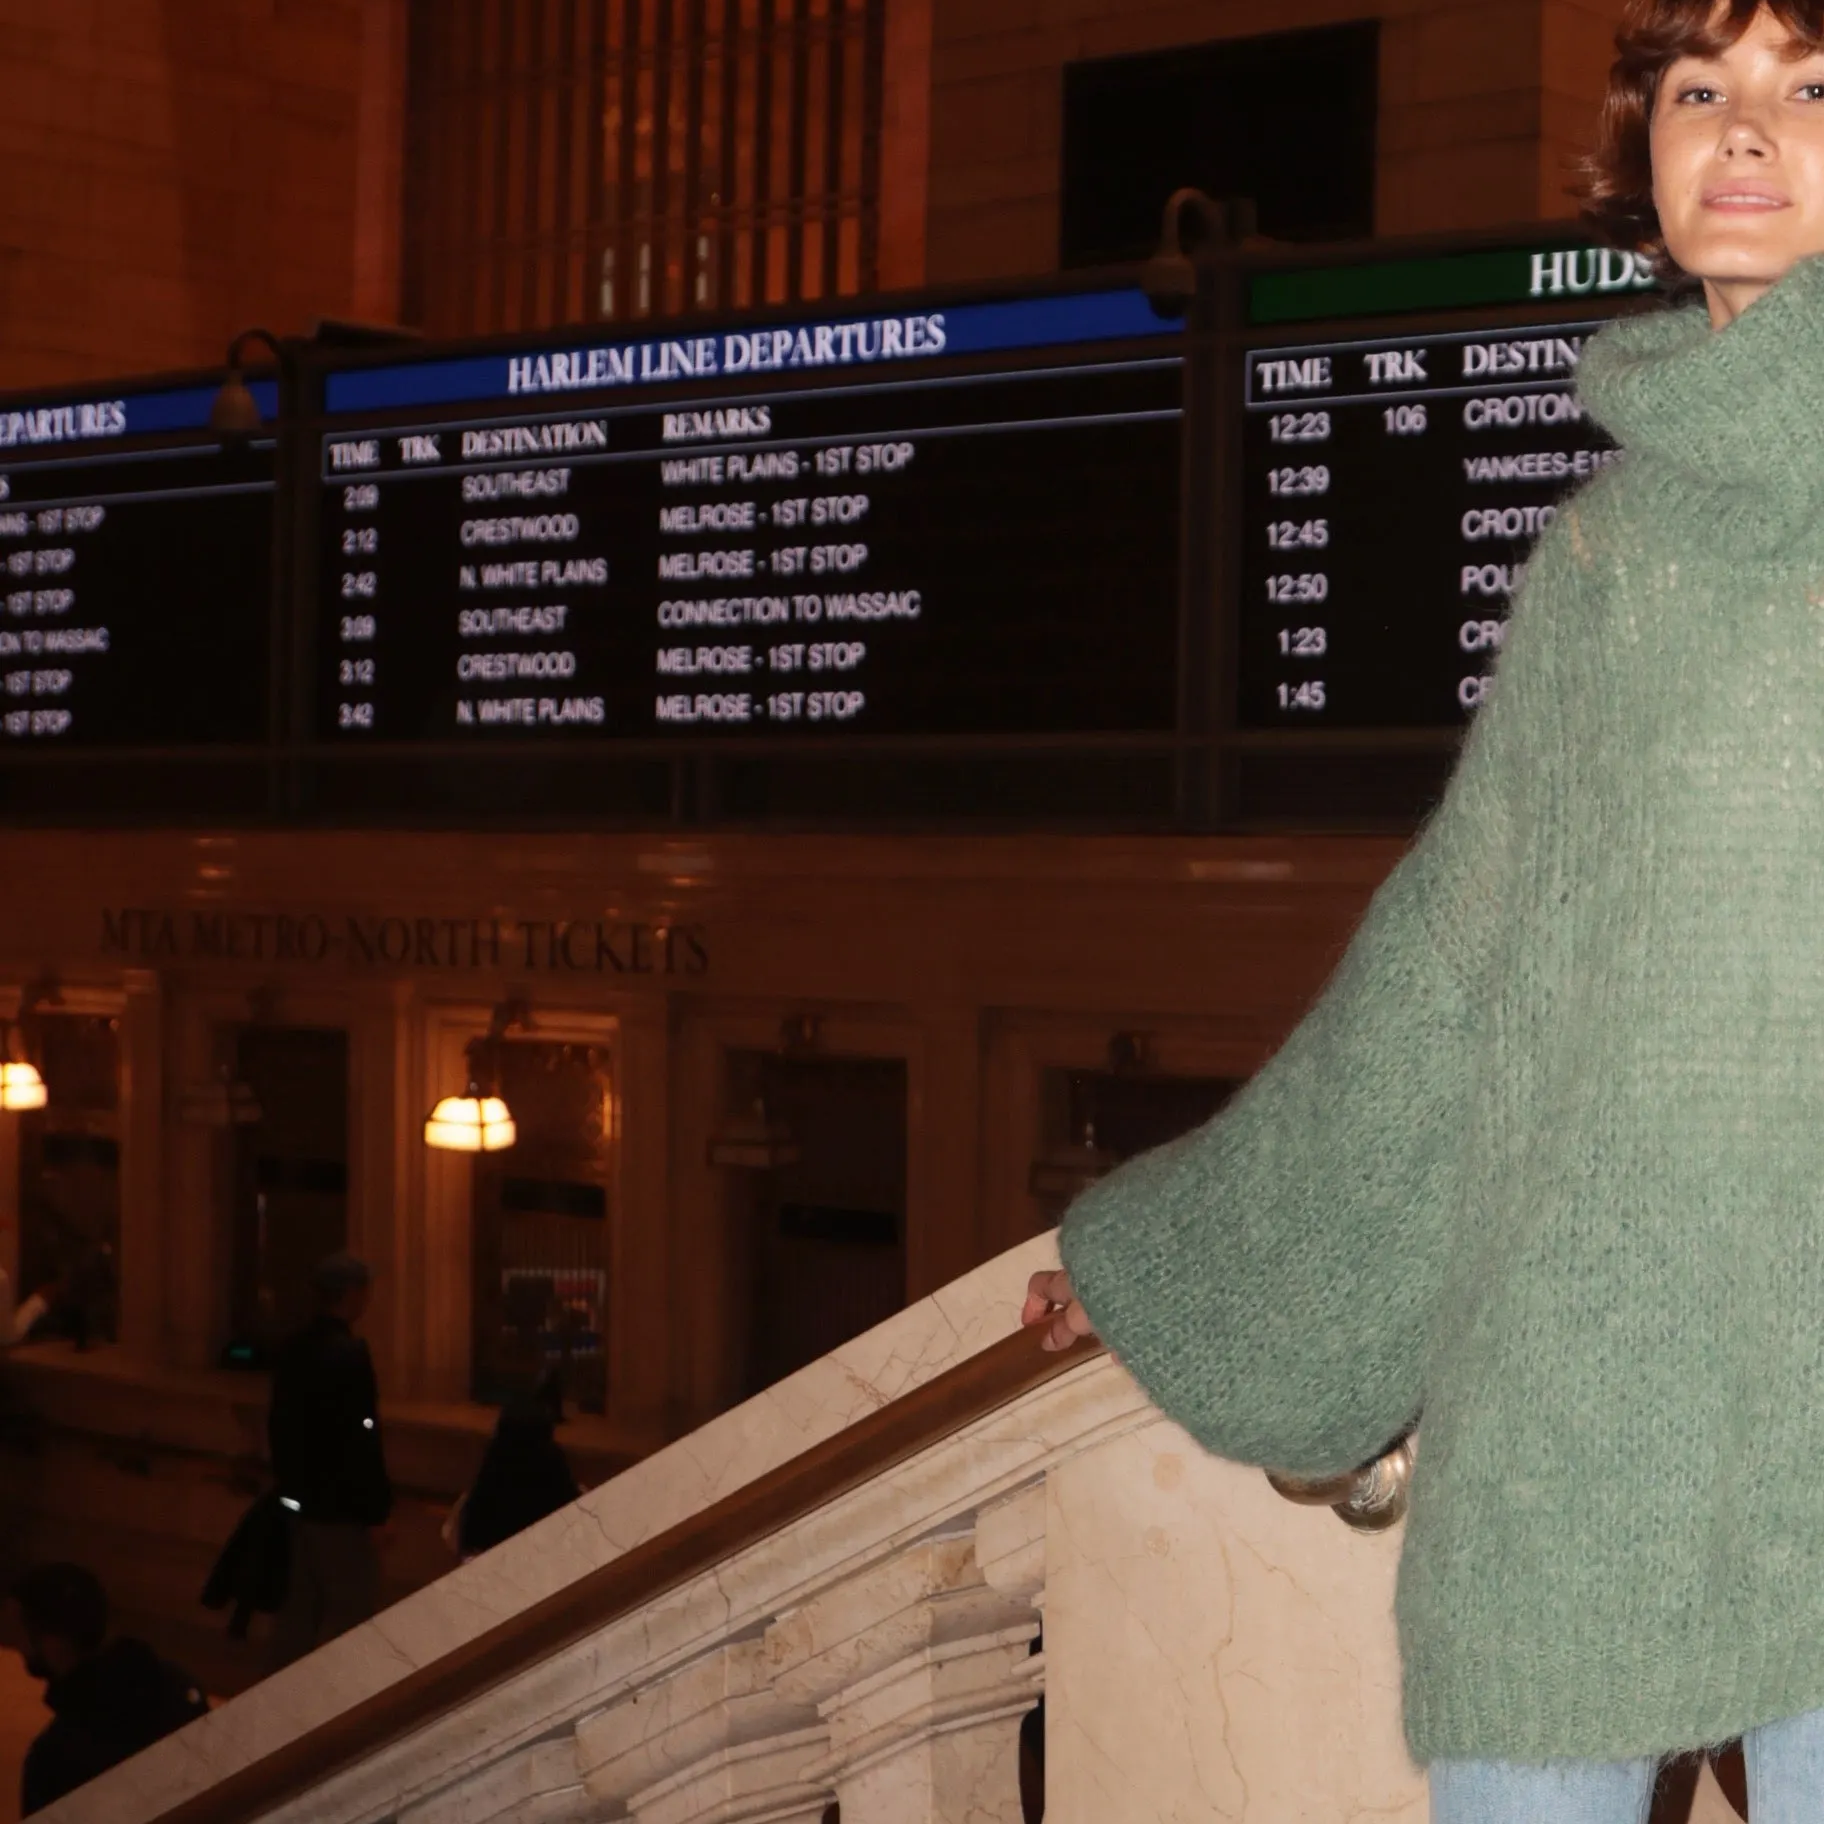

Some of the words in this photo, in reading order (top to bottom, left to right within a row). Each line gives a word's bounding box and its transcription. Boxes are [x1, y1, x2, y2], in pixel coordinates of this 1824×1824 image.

[1529, 247, 1656, 297] HUDS
[507, 346, 634, 394] HARLEM
[640, 337, 716, 381] LINE
[723, 314, 947, 373] DEPARTURES
[1256, 356, 1333, 393] TIME
[1363, 349, 1428, 386] TRK
[1461, 336, 1582, 379] DESTIN
[0, 401, 126, 447] EPARTURES
[330, 439, 381, 471] TIME
[398, 433, 442, 464] TRK
[460, 419, 608, 460] DESTINATION
[662, 405, 772, 443] REMARKS
[1268, 411, 1331, 444] 12:23
[1384, 404, 1427, 437] 106
[1463, 393, 1580, 431] CROTON
[461, 468, 571, 503] SOUTHEAST
[660, 456, 725, 486] WHITE
[727, 450, 800, 484] PLAINS
[814, 446, 853, 476] 1ST
[855, 441, 915, 475] STOP
[1267, 464, 1331, 498] 12:39
[459, 512, 580, 548] CRESTWOOD
[659, 501, 757, 534] MELROSE
[771, 497, 809, 528] 1ST
[811, 494, 870, 526] STOP
[1266, 518, 1329, 551] 12:45
[1461, 505, 1556, 542] CROTO
[480, 560, 539, 589] WHITE
[541, 557, 608, 587] PLAINS
[657, 549, 756, 581] MELROSE
[769, 546, 808, 577] 1ST
[809, 543, 869, 575] STOP
[1265, 572, 1328, 605] 12:50
[457, 604, 568, 638] SOUTHEAST
[657, 597, 790, 629] CONNECTION
[792, 593, 822, 624] TO
[824, 589, 922, 622] WASSAIC
[456, 651, 576, 683] CRESTWOOD
[655, 645, 753, 675] MELROSE
[767, 644, 806, 673] 1ST
[807, 641, 867, 672] STOP
[1278, 626, 1327, 658] 1:23
[477, 697, 536, 726] WHITE
[538, 695, 606, 726] PLAINS
[655, 693, 752, 723] MELROSE
[766, 692, 805, 722] 1ST
[806, 690, 866, 722] STOP
[1276, 680, 1327, 712] 1:45
[99, 908, 178, 956] MTA
[192, 911, 500, 968] METRO-NORTH
[516, 920, 710, 975] TICKETS
